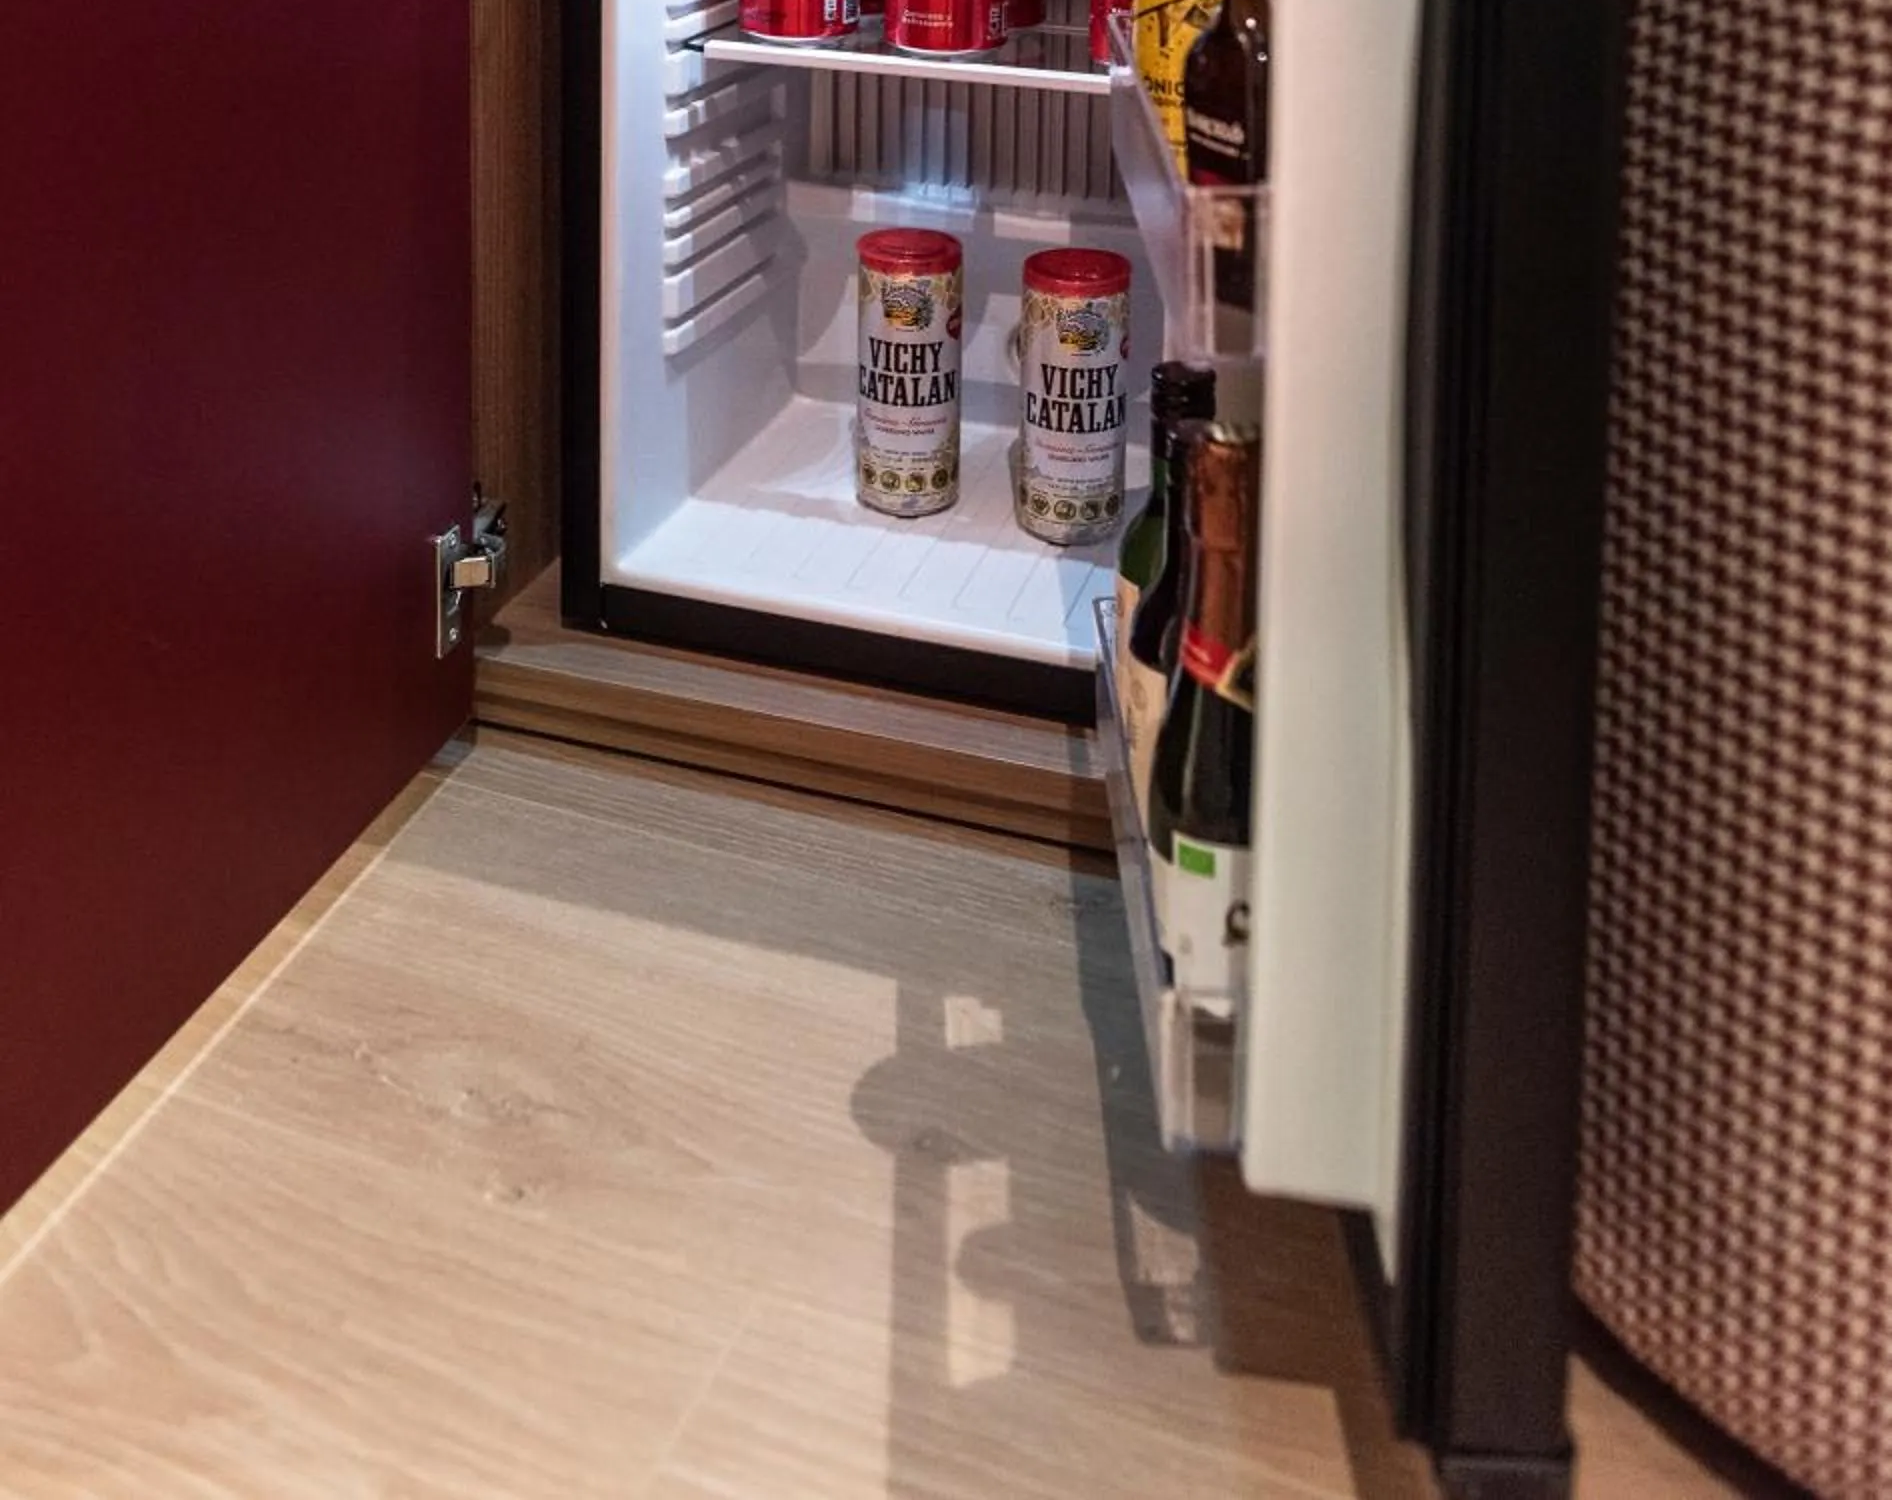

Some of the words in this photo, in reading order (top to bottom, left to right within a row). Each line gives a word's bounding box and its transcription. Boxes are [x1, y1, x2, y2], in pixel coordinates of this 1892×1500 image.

[868, 336, 944, 374] VICHY
[860, 363, 956, 407] CATALAN
[1041, 363, 1118, 399] VICHY
[1027, 391, 1126, 433] CATALAN
